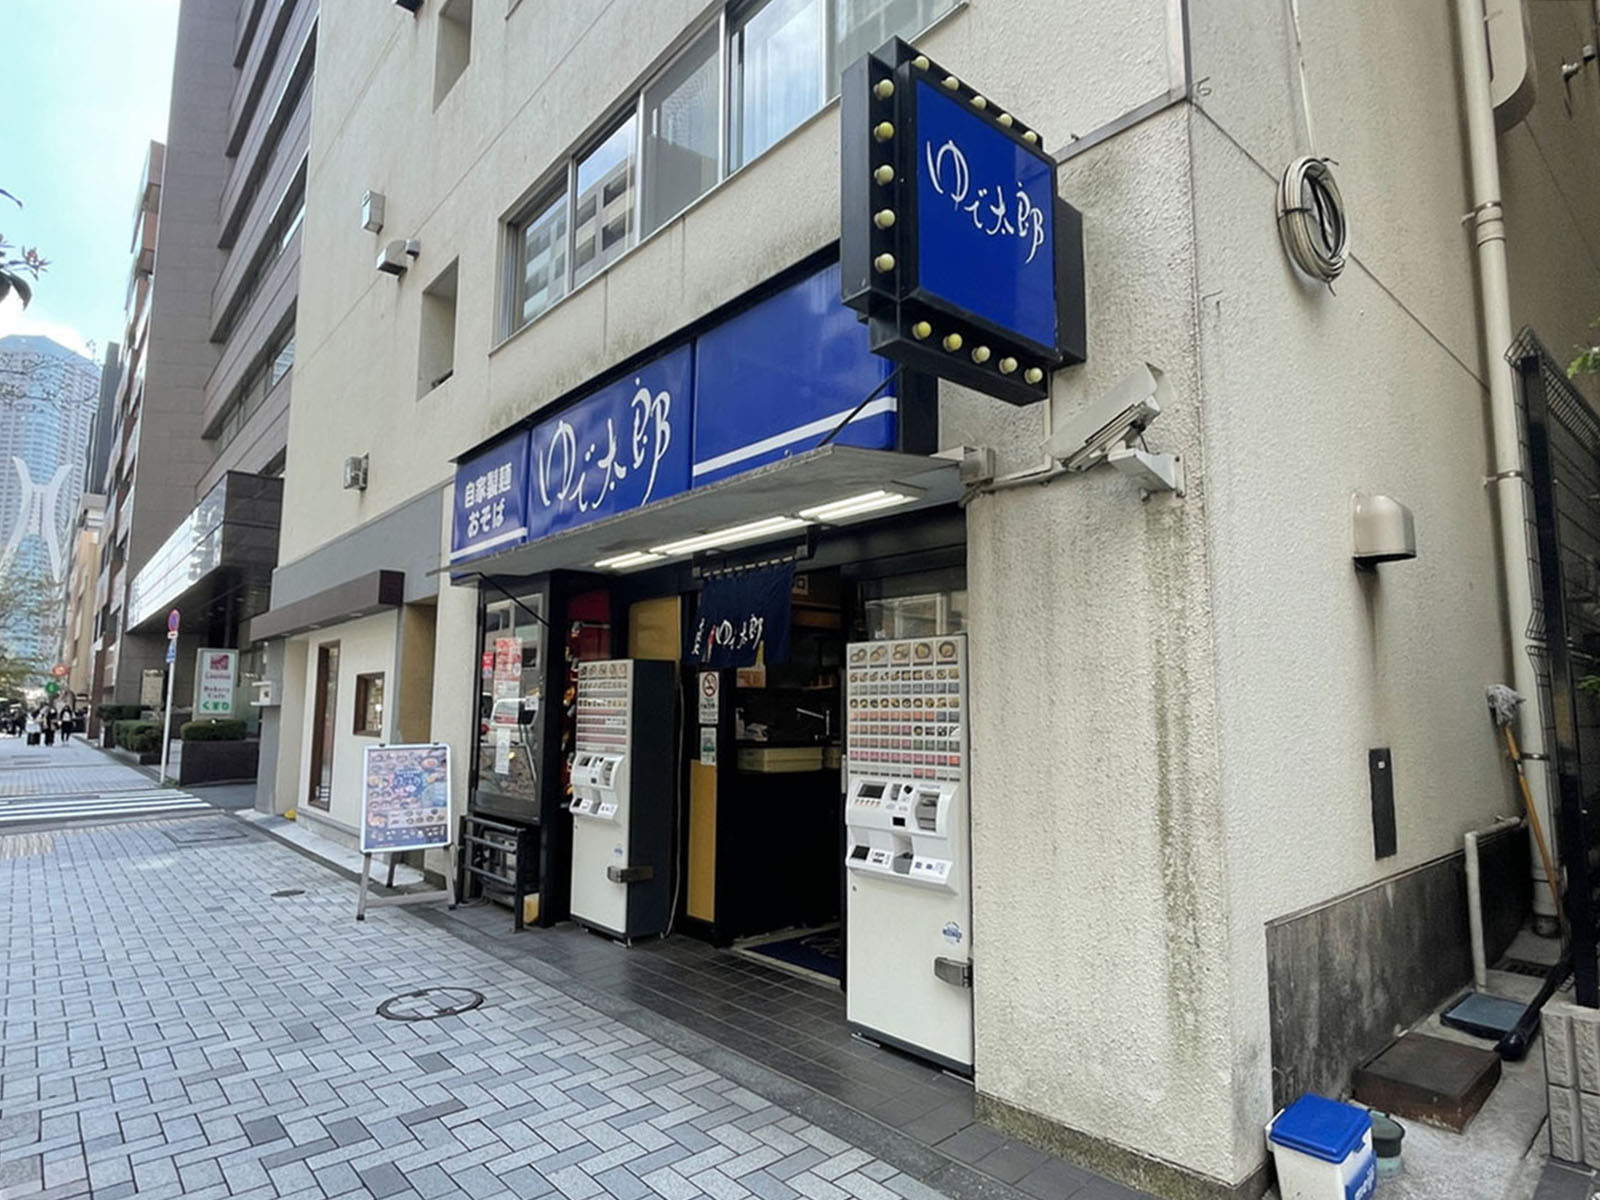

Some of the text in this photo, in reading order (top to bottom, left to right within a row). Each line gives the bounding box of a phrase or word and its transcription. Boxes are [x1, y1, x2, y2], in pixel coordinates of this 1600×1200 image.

[927, 139, 1045, 264] ゆで太郎
[464, 462, 512, 508] 自家製麺
[539, 377, 671, 511] ゆで太郎
[467, 497, 505, 538] おそば
